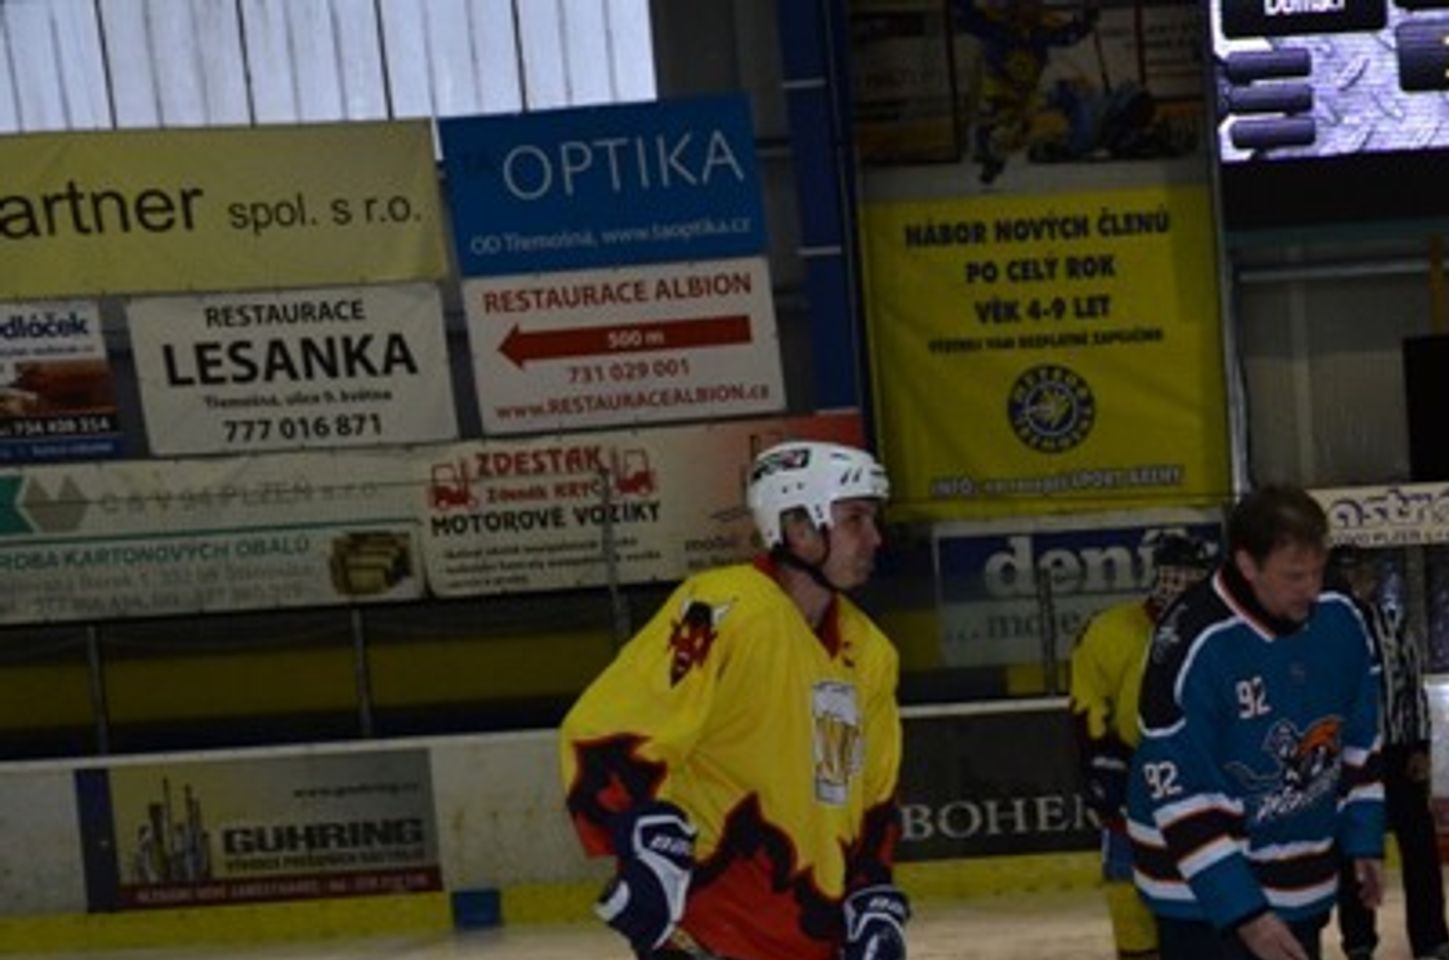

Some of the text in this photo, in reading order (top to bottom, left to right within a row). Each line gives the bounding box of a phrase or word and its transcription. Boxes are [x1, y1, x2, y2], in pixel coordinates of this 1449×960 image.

[503, 128, 745, 200] OPTIKA
[228, 193, 318, 235] spol.
[331, 199, 353, 226] s
[365, 195, 422, 224] r.o.
[965, 261, 998, 284] PO
[1065, 255, 1116, 279] ROK
[483, 273, 751, 314] RESTAURACE ALBION
[974, 295, 1112, 324] VĚK 4-9 LET
[204, 299, 366, 328] RESTAURACE
[607, 330, 642, 349] 500
[162, 332, 419, 387] LESANKA
[570, 358, 690, 383] 731 029 001
[224, 413, 382, 443] 777 016 871
[1235, 674, 1273, 720] 92
[1143, 759, 1184, 800] 92
